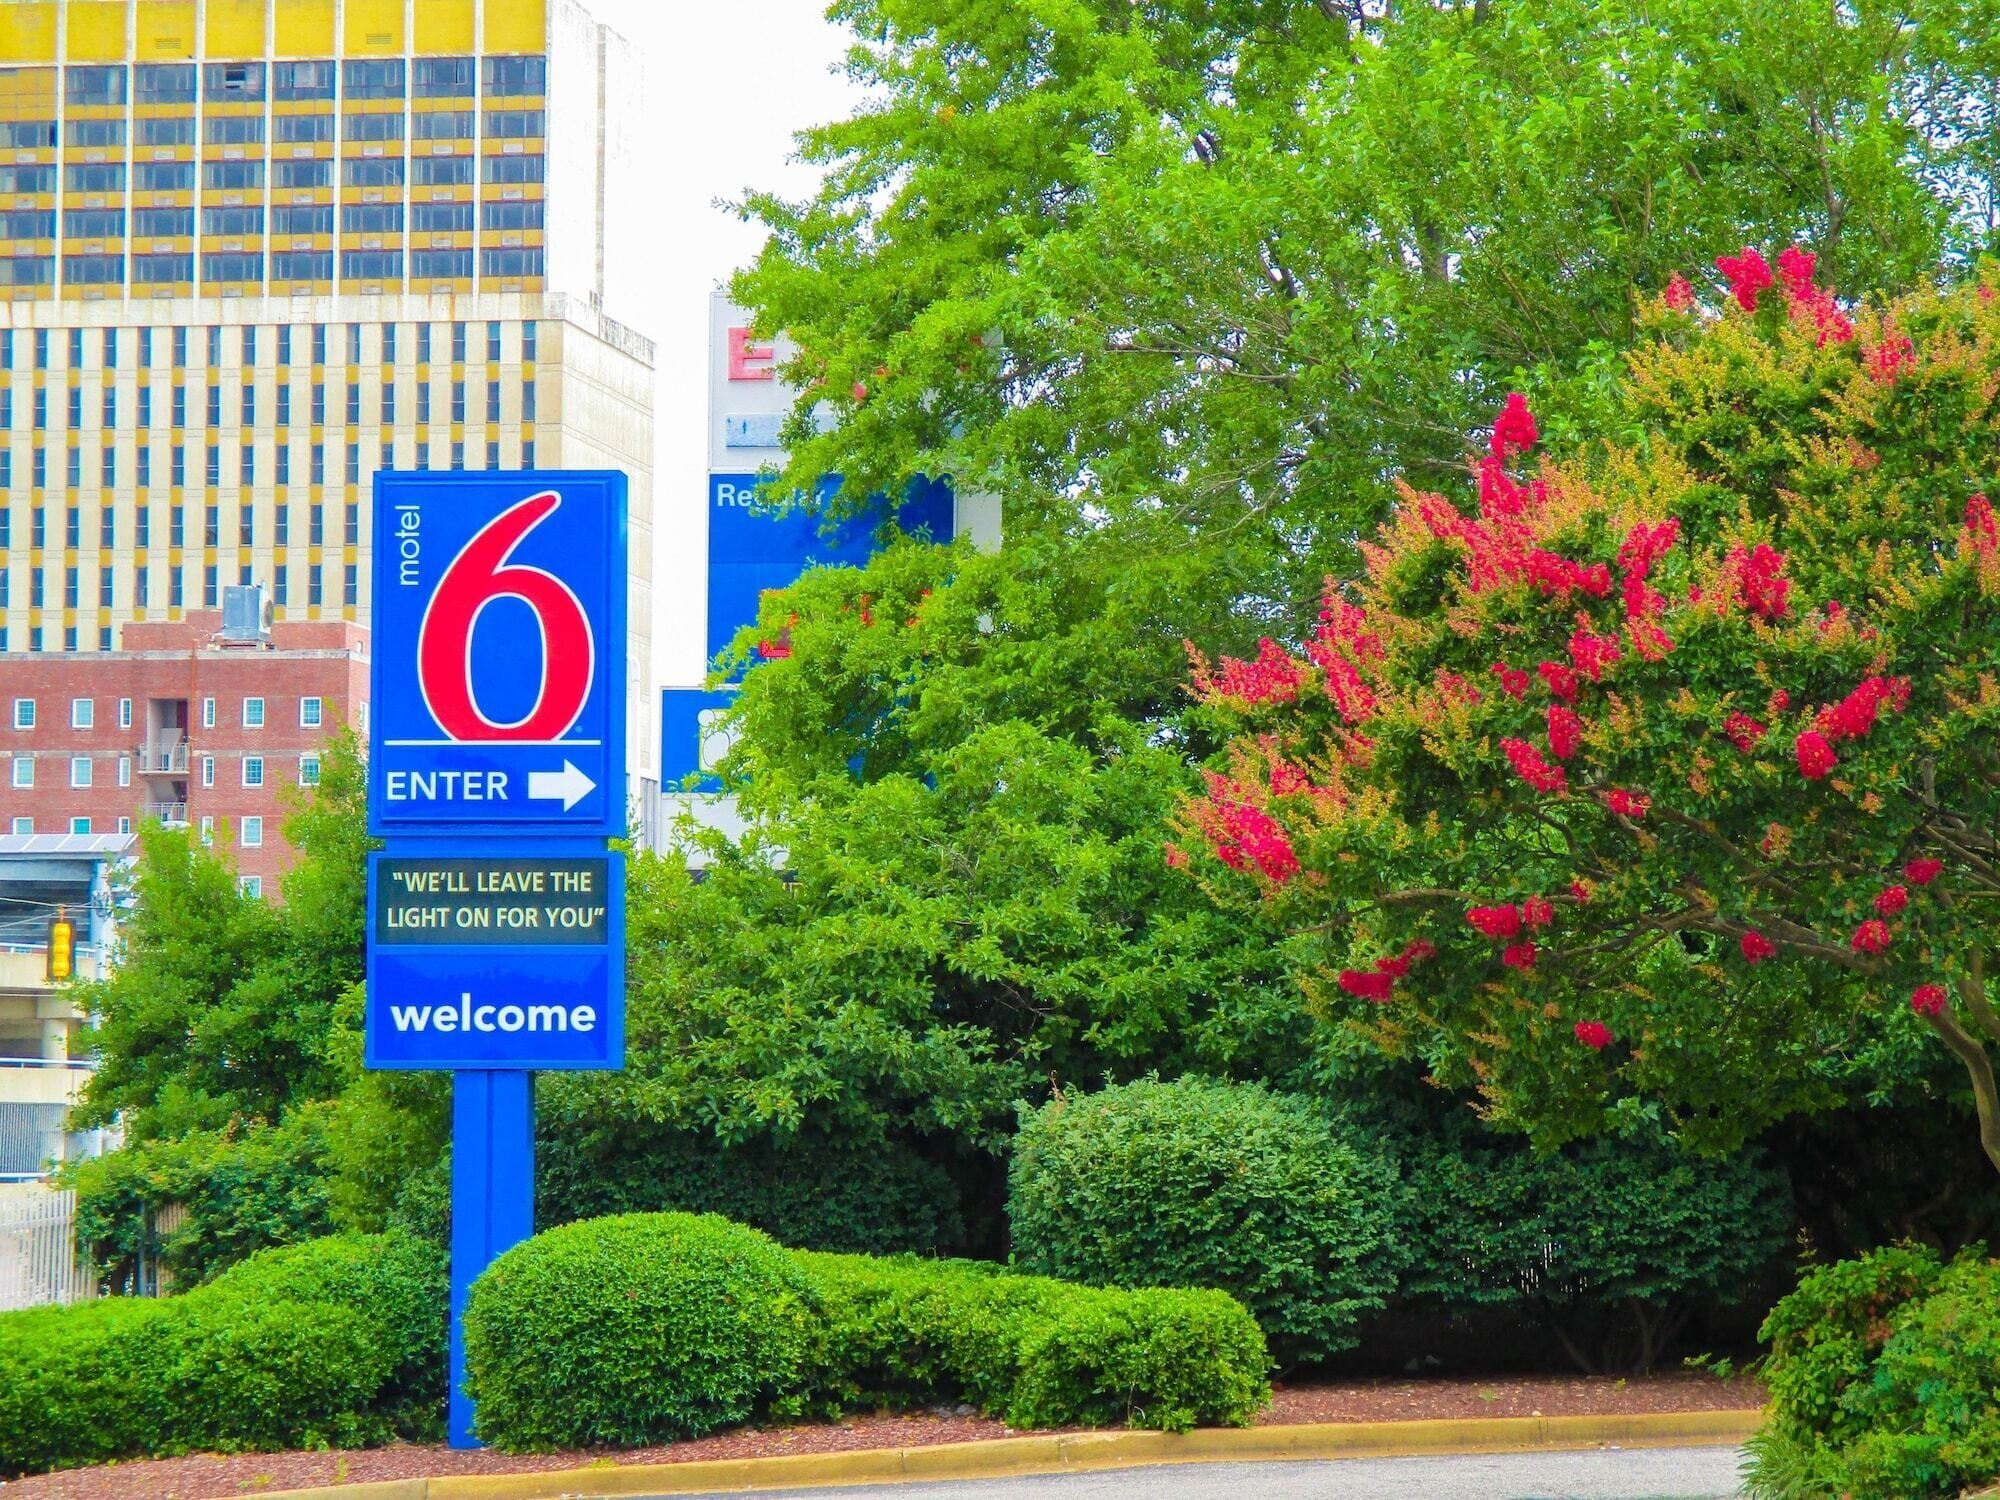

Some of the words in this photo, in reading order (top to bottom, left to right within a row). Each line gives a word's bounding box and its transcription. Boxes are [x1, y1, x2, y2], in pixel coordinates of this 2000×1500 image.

[395, 504, 421, 587] motel
[417, 490, 594, 743] 6
[386, 771, 509, 801] ENTER
[477, 871, 544, 893] LEAVE
[550, 871, 592, 893] THE
[387, 907, 450, 928] LIGHT
[455, 907, 489, 929] ON
[496, 907, 538, 928] FOR
[545, 907, 605, 929] YOU”
[390, 992, 596, 1032] welcome
